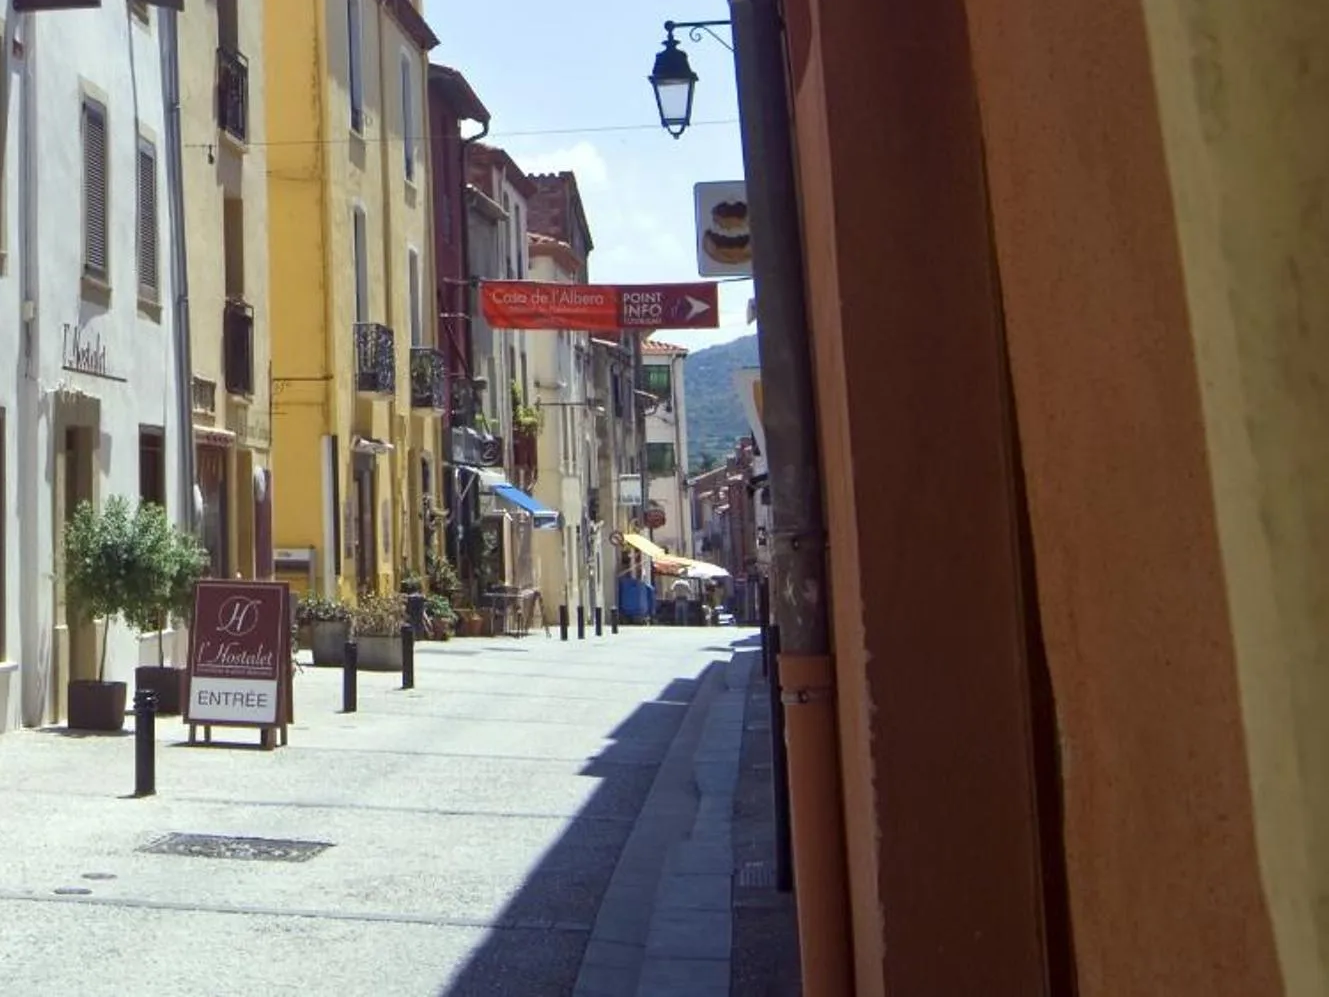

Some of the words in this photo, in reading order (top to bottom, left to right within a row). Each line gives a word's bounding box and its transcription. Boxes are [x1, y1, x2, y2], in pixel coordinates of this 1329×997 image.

[531, 289, 549, 305] de
[623, 292, 661, 304] POINT
[623, 304, 662, 317] INFO
[197, 690, 269, 708] ENTRÉE
